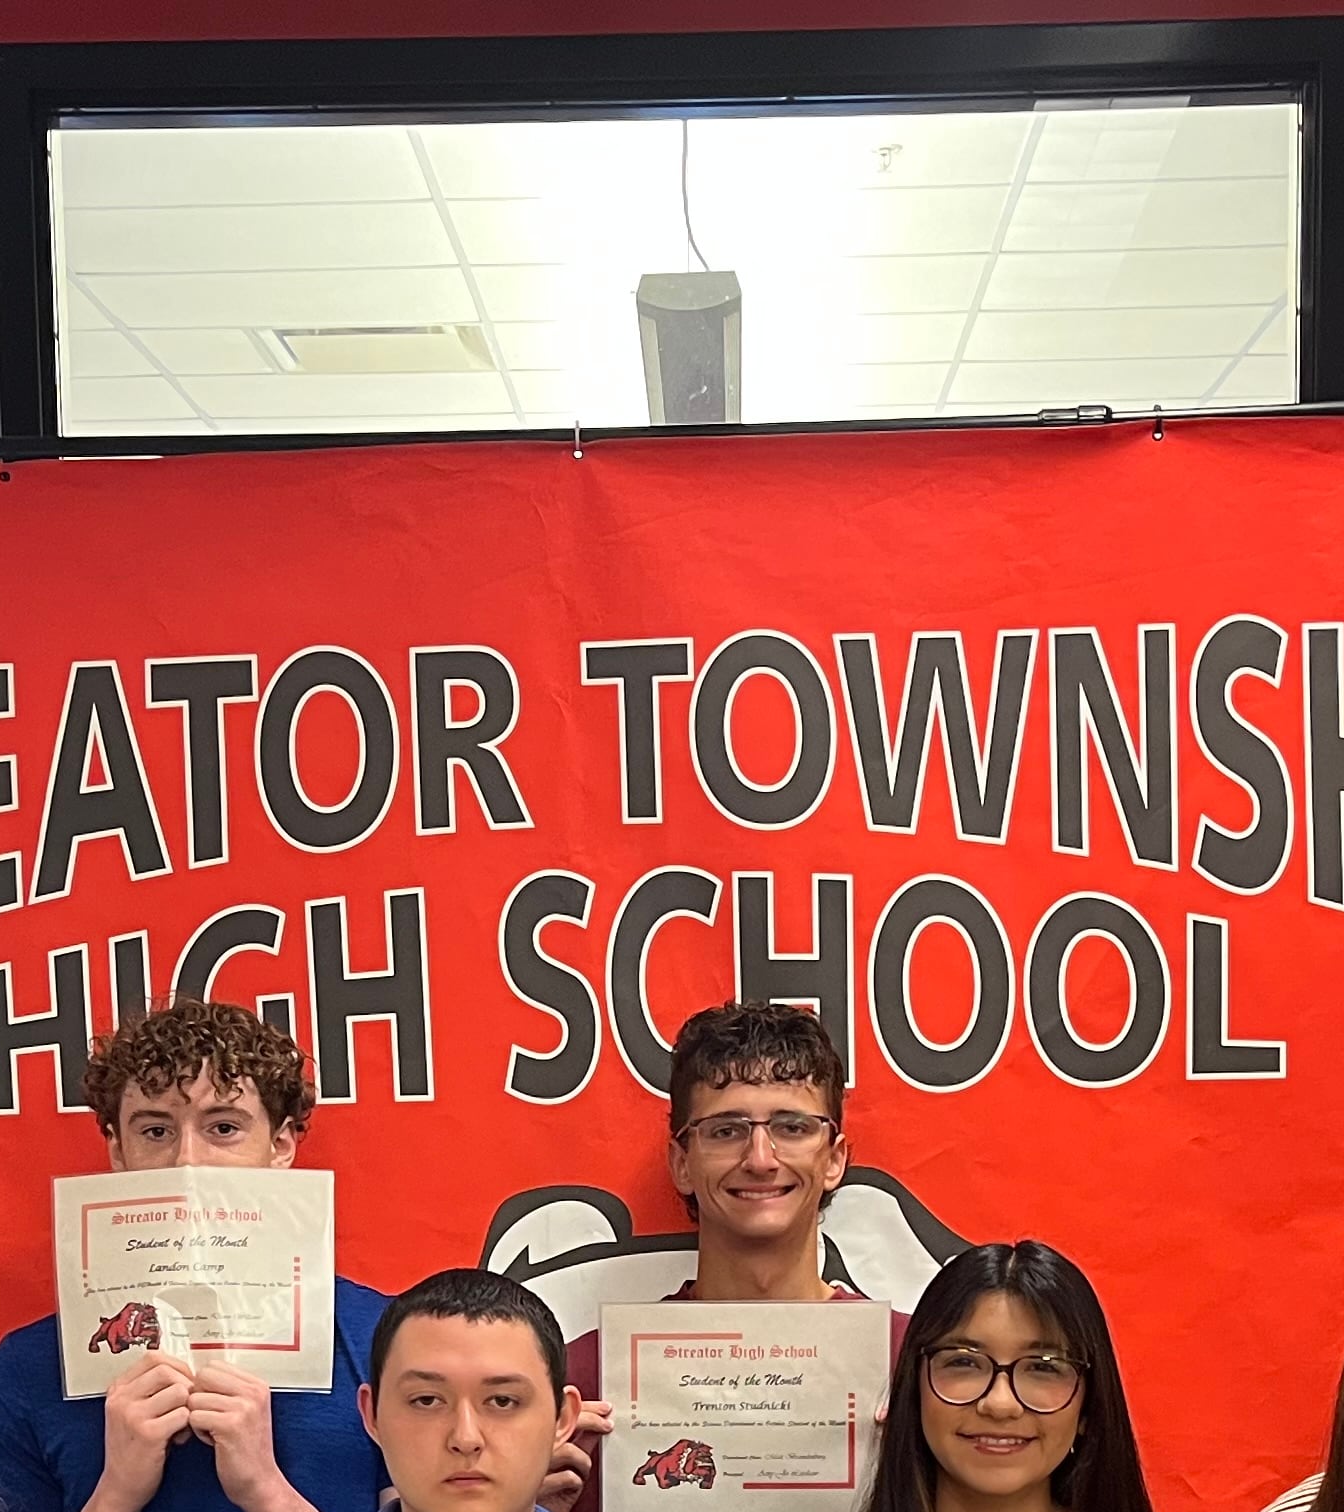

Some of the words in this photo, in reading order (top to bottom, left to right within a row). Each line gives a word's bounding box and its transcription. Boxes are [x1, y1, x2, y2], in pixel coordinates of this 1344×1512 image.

[497, 864, 1288, 1106] SCHOOL
[112, 1210, 168, 1224] Streator
[174, 1208, 210, 1222] High
[216, 1208, 263, 1222] School
[126, 1238, 169, 1251] Student
[174, 1236, 184, 1250] of
[189, 1235, 206, 1246] the
[210, 1236, 248, 1248] Month
[149, 1262, 189, 1272] Landon
[194, 1262, 224, 1273] Camp
[664, 1345, 723, 1359] Streator
[729, 1344, 764, 1359] High
[769, 1345, 817, 1358] School
[679, 1375, 725, 1387] Student
[729, 1375, 740, 1388] of
[745, 1373, 761, 1386] the
[765, 1373, 802, 1386] Month
[693, 1402, 736, 1411] Trenton
